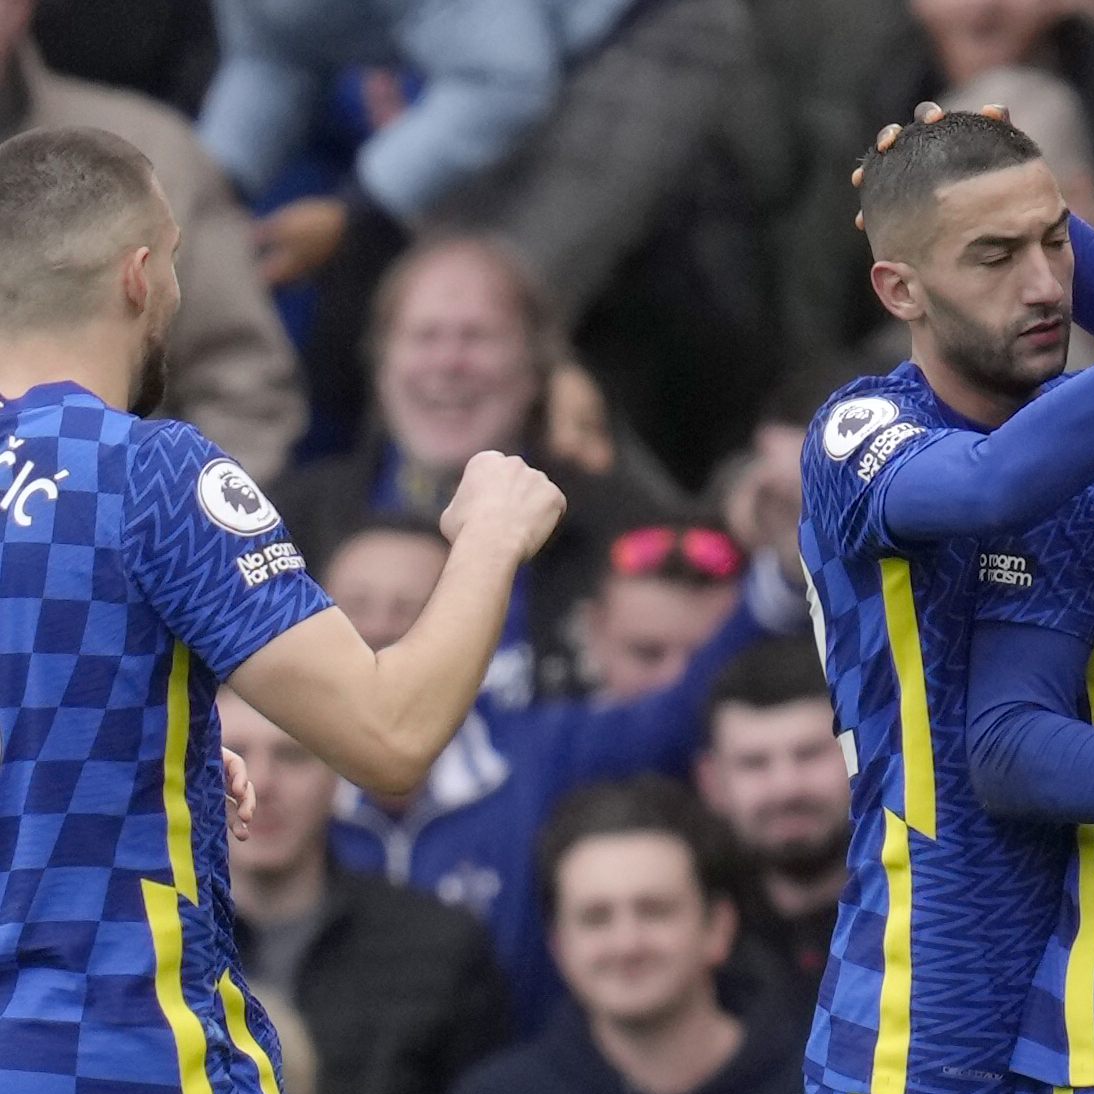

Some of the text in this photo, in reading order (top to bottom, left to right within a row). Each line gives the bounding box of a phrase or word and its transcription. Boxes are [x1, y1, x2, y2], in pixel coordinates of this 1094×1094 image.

[857, 453, 874, 483] No
[237, 553, 265, 571] No
[988, 554, 1026, 571] room
[243, 564, 269, 586] for
